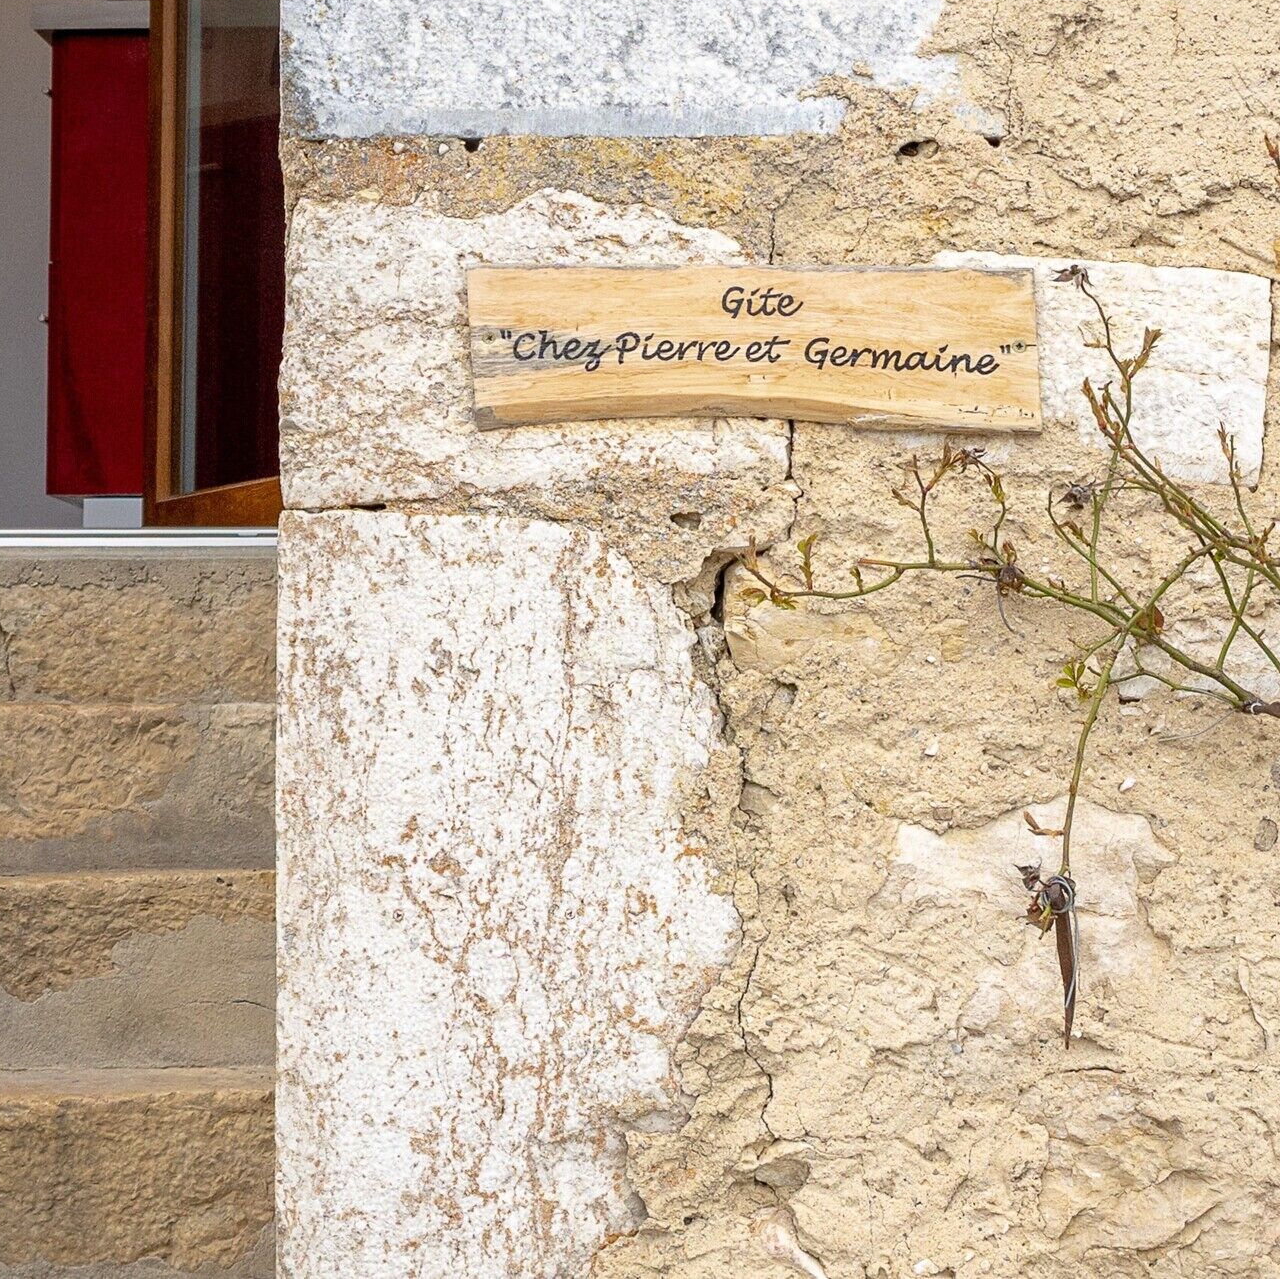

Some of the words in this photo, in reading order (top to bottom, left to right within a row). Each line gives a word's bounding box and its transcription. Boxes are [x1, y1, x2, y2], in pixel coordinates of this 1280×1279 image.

[499, 329, 612, 372] "Chez
[614, 331, 741, 365] Pierre
[745, 335, 791, 363] et
[804, 336, 1012, 375] Germaine"
